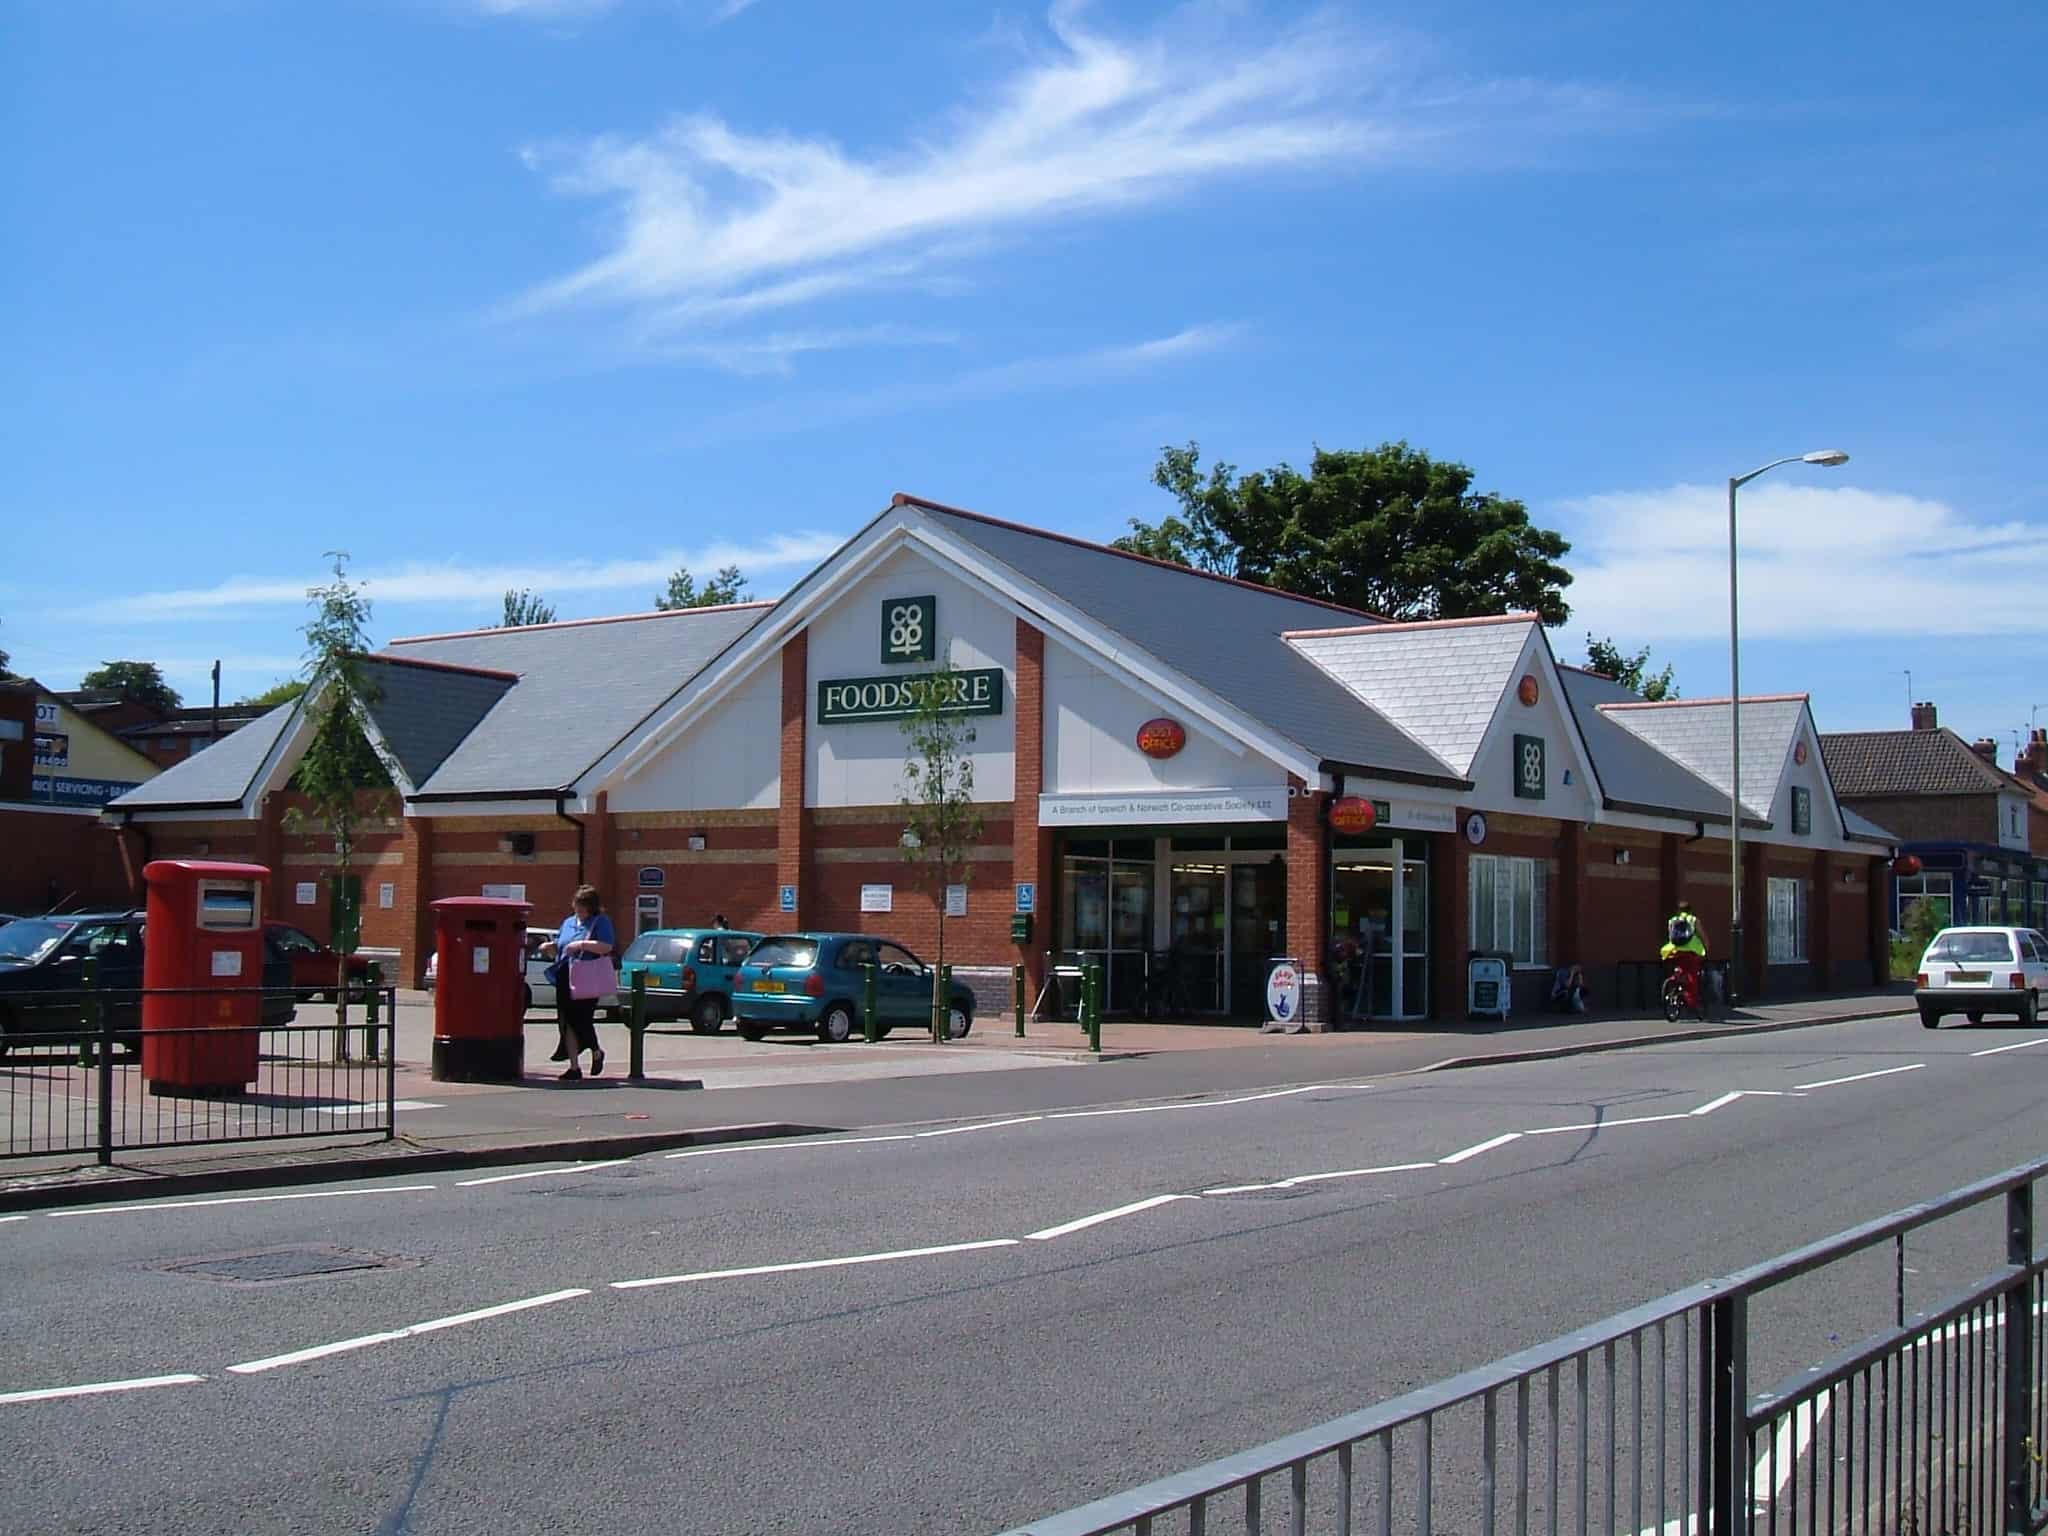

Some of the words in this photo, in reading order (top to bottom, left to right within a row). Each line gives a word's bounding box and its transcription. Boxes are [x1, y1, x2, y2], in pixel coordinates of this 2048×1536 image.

[1141, 738, 1177, 751] OFFICE
[56, 782, 103, 796] SERVICING
[1060, 804, 1086, 815] Branch
[1099, 803, 1127, 816] Ipswich
[1137, 802, 1169, 812] Norwich
[1170, 800, 1222, 813] Co-operative
[1335, 815, 1367, 826] OFFICE
